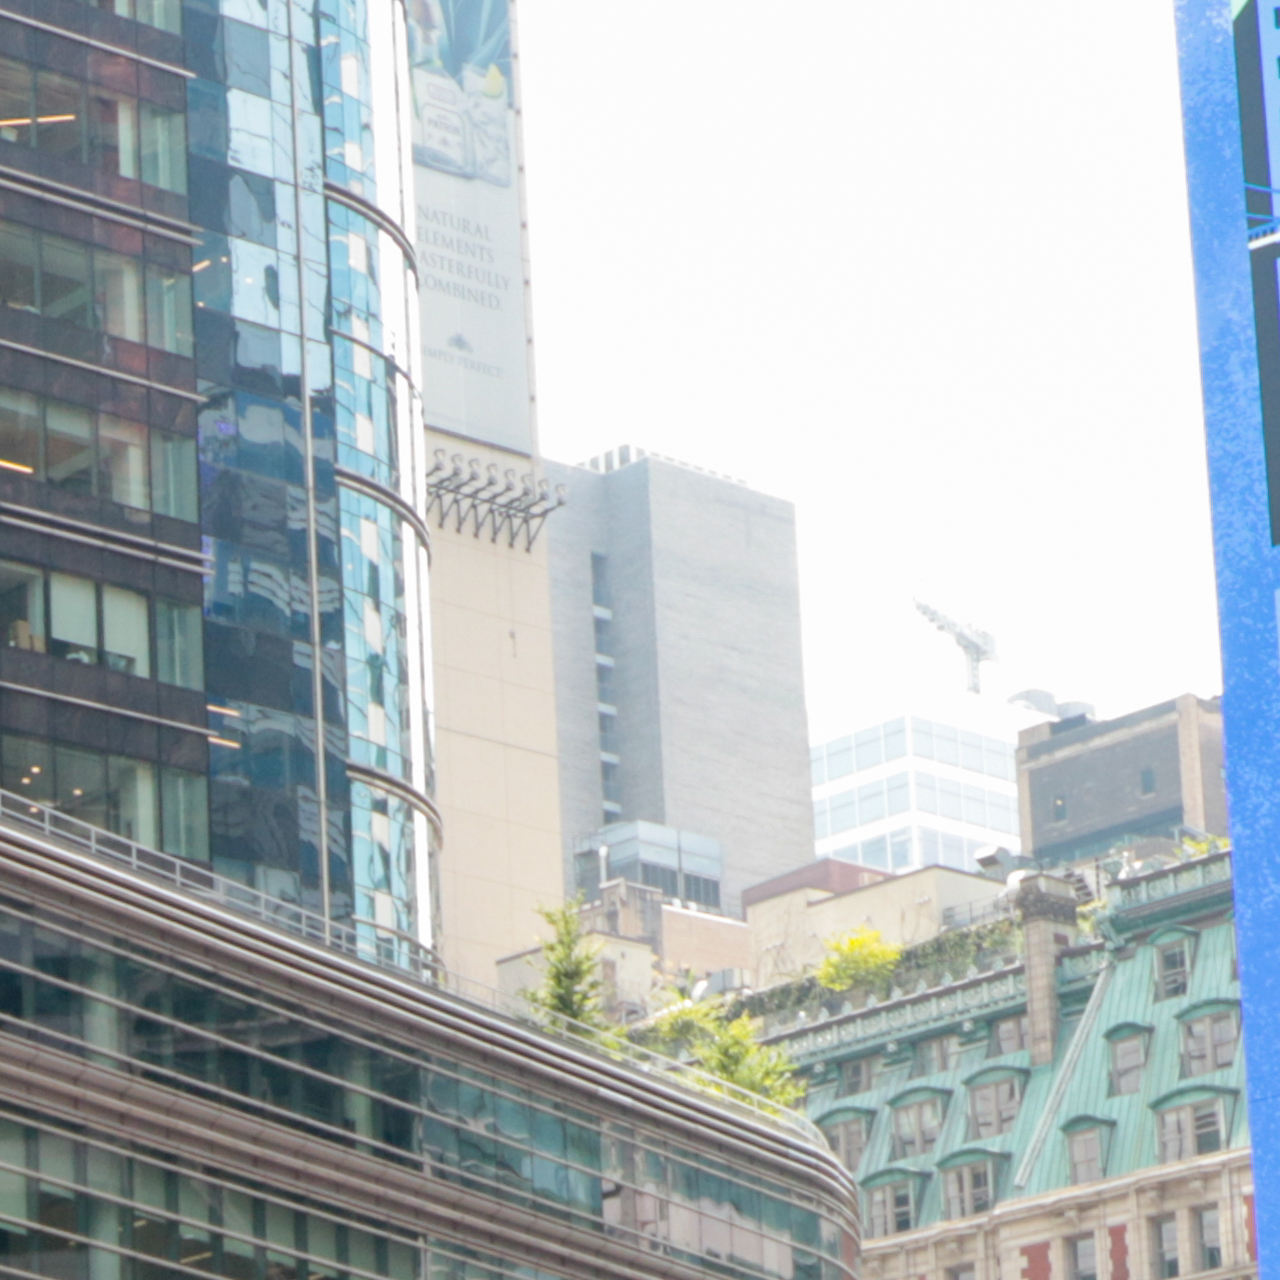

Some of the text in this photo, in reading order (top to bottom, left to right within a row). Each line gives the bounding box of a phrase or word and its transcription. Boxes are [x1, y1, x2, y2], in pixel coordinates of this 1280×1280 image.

[418, 204, 492, 242] NATURAL
[417, 226, 495, 263] ELEMENTS
[420, 250, 510, 291] ASTERFULLY
